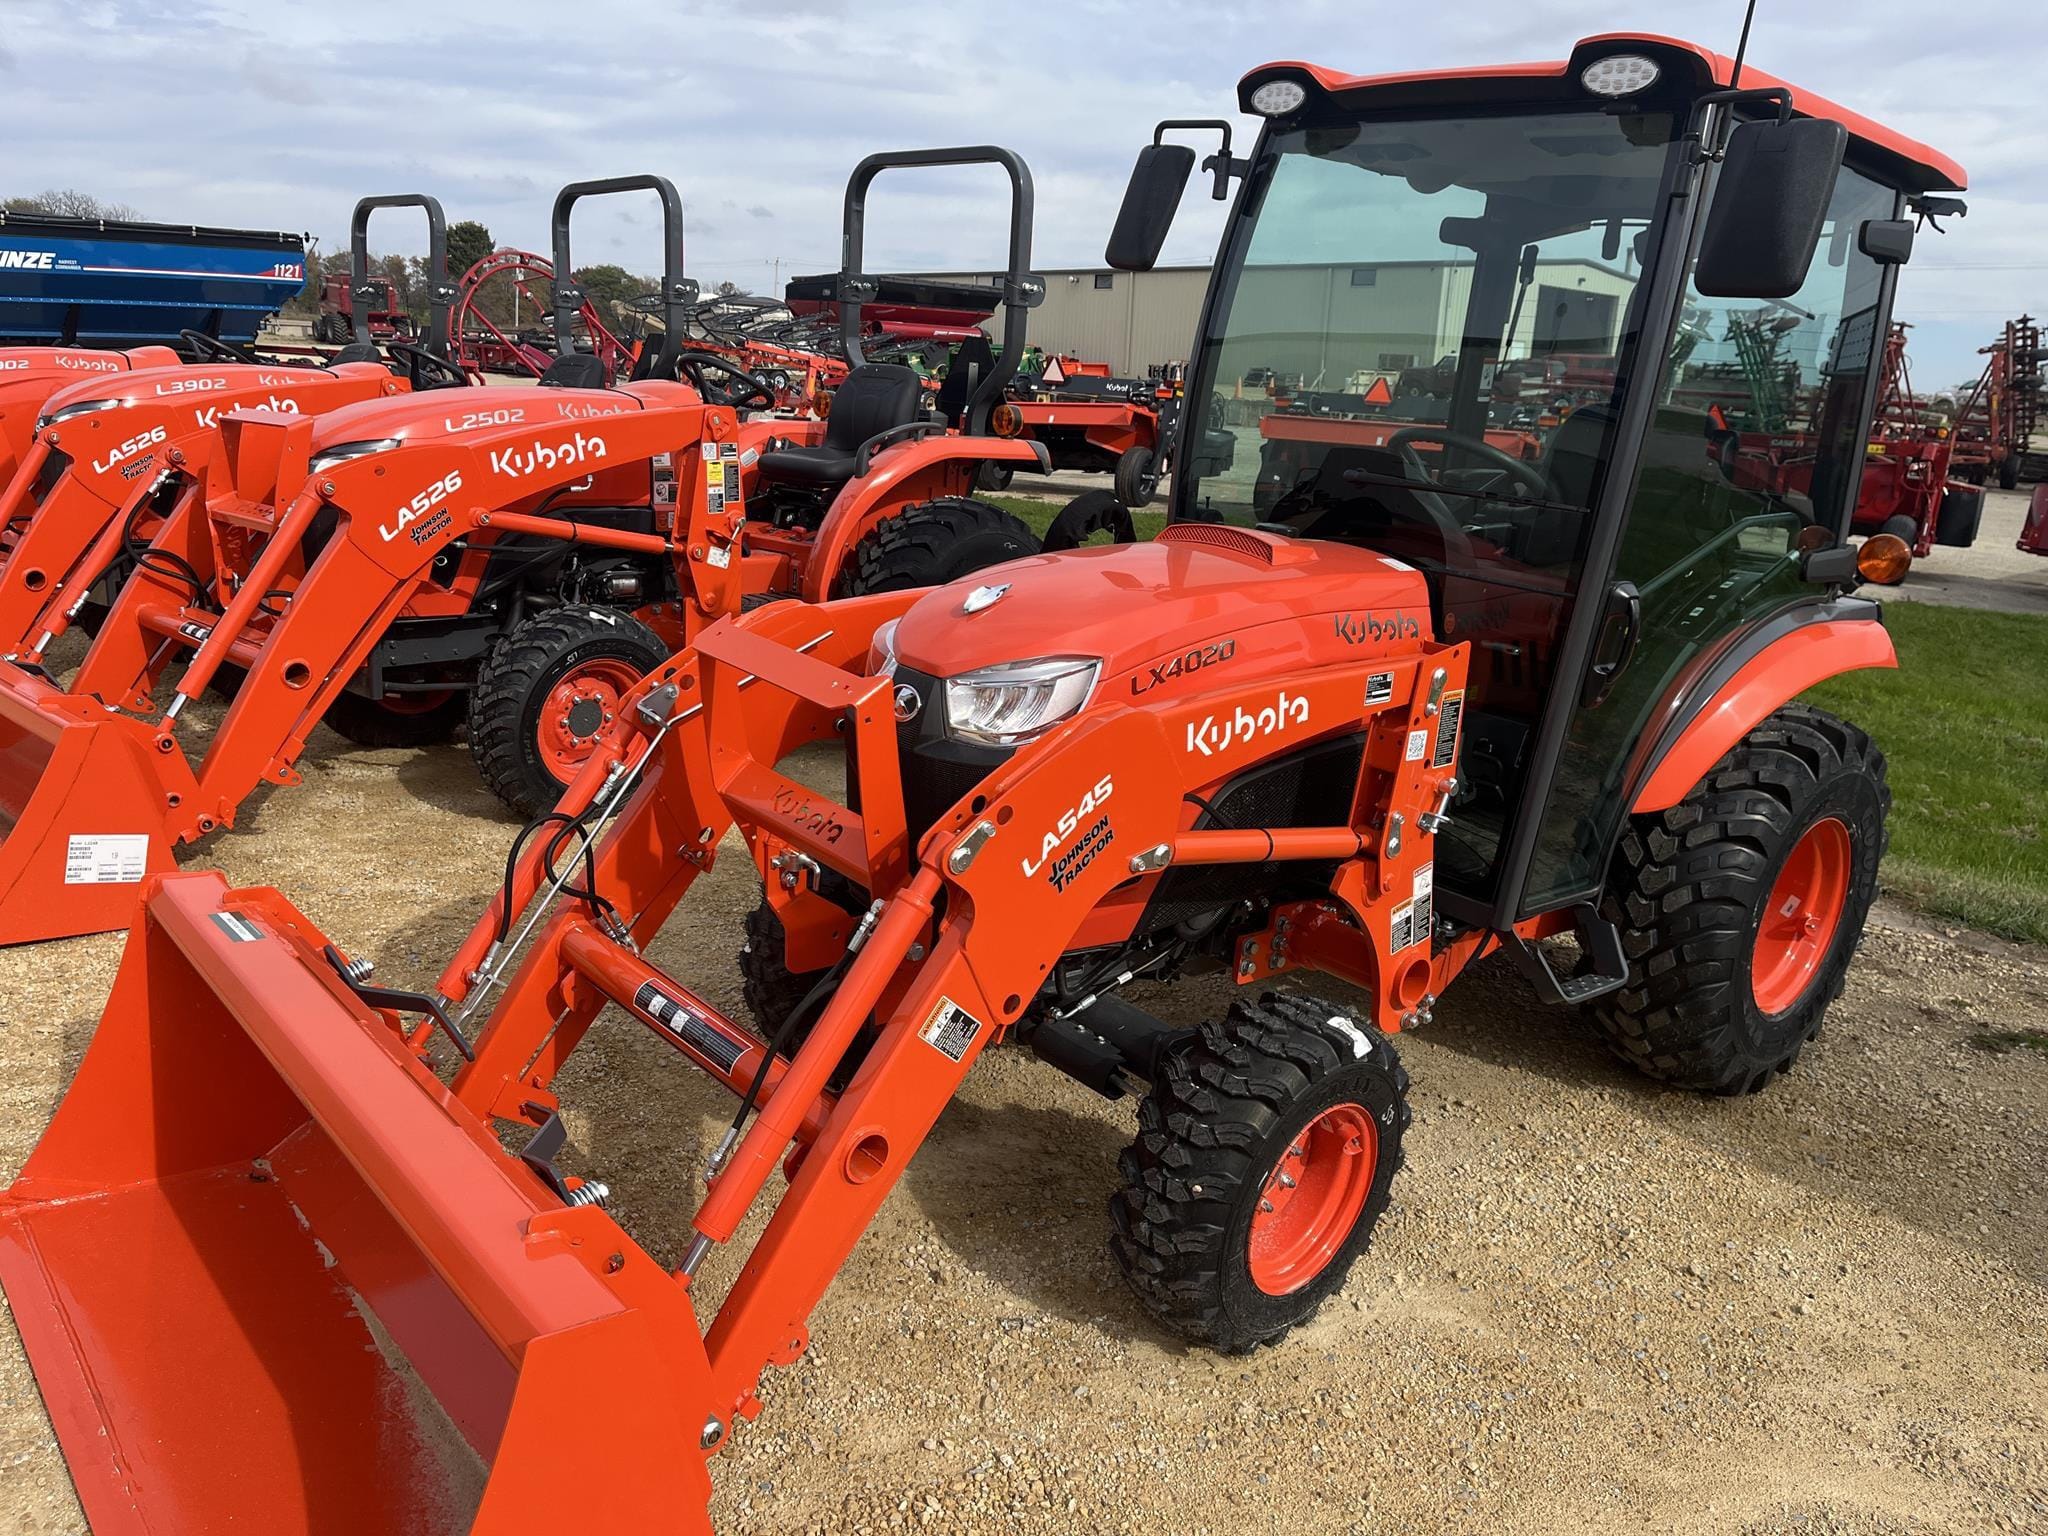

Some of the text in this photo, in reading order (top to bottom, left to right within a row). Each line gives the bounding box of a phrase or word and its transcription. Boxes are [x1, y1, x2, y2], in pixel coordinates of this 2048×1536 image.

[0, 250, 56, 269] INZE
[273, 263, 300, 278] 1121
[55, 355, 119, 372] Kubota
[155, 377, 228, 396] L3902
[445, 408, 526, 433] L2502
[92, 425, 167, 475] LA526
[121, 453, 154, 475] JOHNSON
[490, 431, 607, 478] Kubota
[123, 462, 153, 481] TRACT
[378, 469, 463, 542] LA526
[410, 507, 448, 539] JOHNSON
[413, 516, 452, 546] TRACTOR
[1334, 610, 1419, 645] Kubota
[1130, 638, 1236, 696] LX4020
[1186, 690, 1309, 757] Kubota
[769, 784, 843, 845] Kubota
[1021, 773, 1113, 878] LA545
[1048, 814, 1109, 883] JOHNSON
[1053, 829, 1114, 894] TRACTOR
